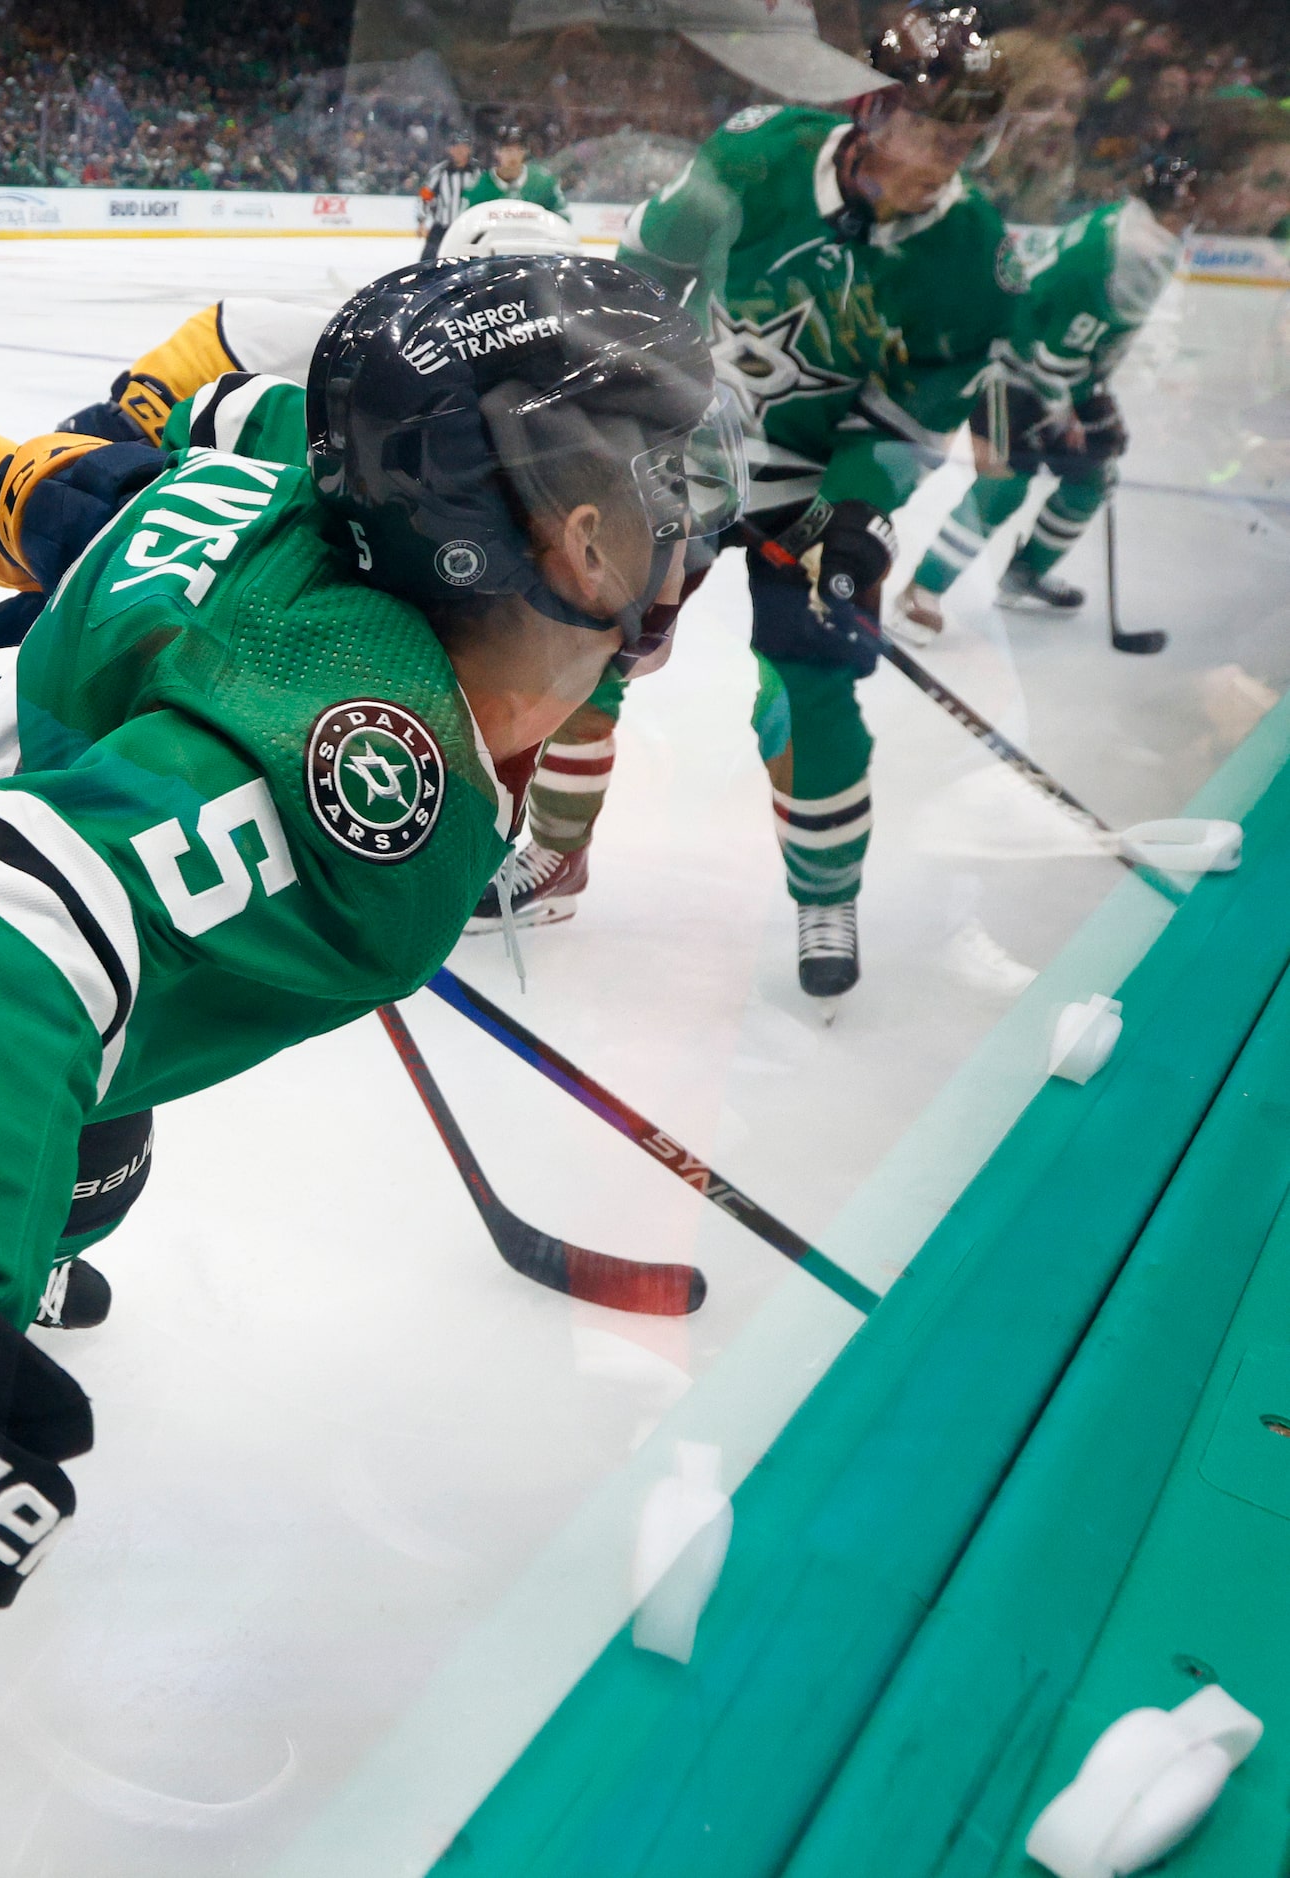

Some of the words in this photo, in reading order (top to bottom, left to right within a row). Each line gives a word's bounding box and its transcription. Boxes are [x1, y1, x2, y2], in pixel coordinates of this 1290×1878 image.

[110, 201, 138, 217] BUD
[141, 201, 180, 217] LIGHT
[443, 299, 527, 341] ENERGY
[452, 315, 564, 361] TRANSFER
[110, 446, 287, 607] KVIST
[348, 519, 373, 572] 5
[318, 741, 392, 850] STARS
[345, 711, 437, 827] DALLAS
[128, 776, 301, 938] 5
[642, 1129, 758, 1217] SYNC
